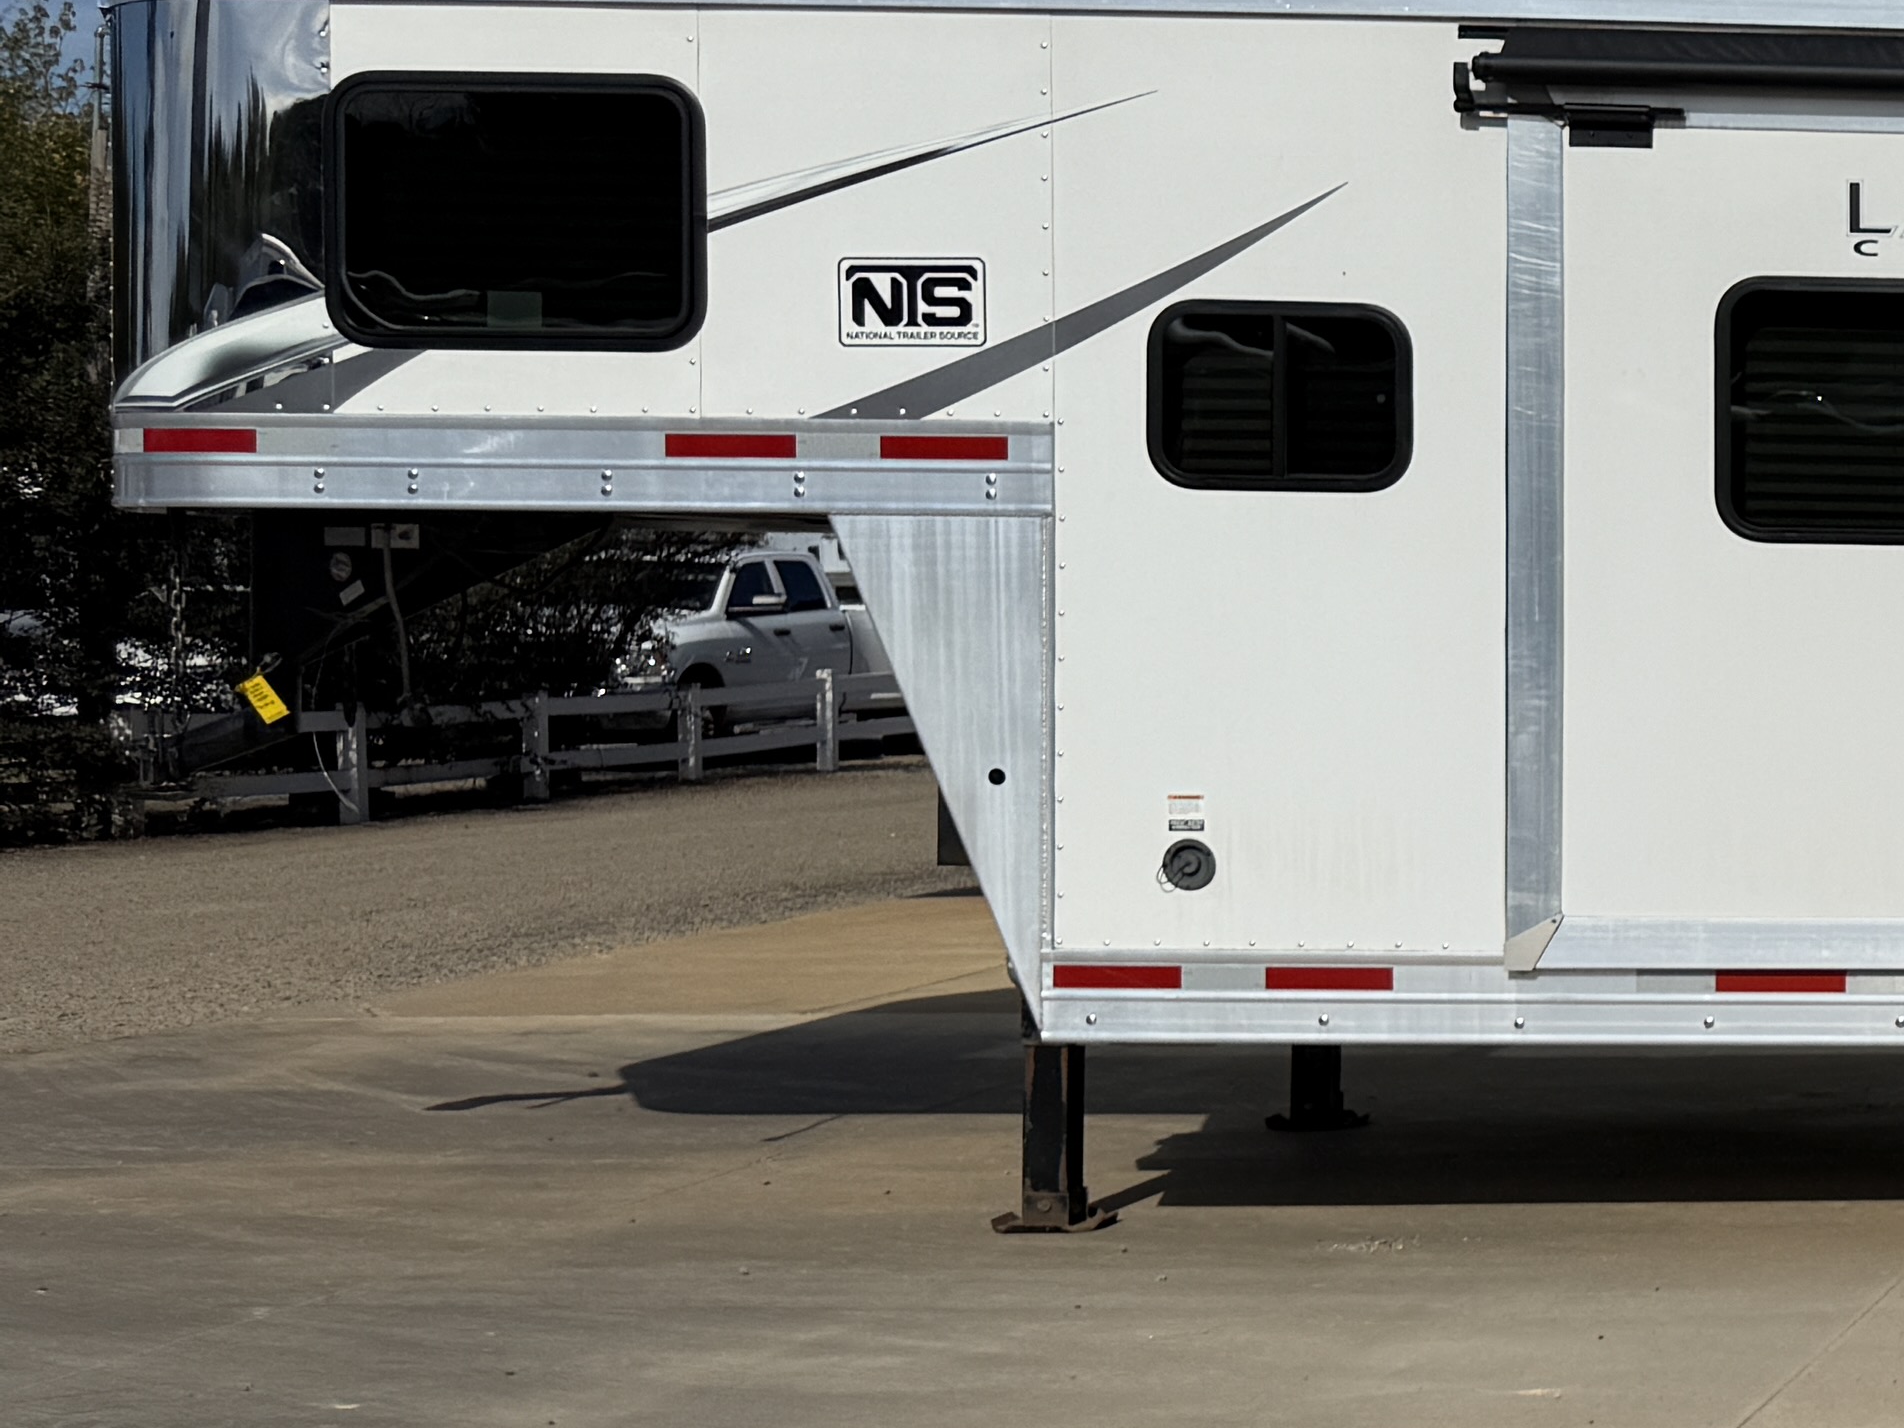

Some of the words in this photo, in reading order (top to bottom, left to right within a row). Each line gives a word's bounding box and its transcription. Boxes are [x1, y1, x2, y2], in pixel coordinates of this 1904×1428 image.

[845, 264, 978, 327] NTS
[846, 331, 894, 340] NATIONAL
[896, 331, 937, 340] TRAILER
[939, 331, 979, 340] SOURCE
